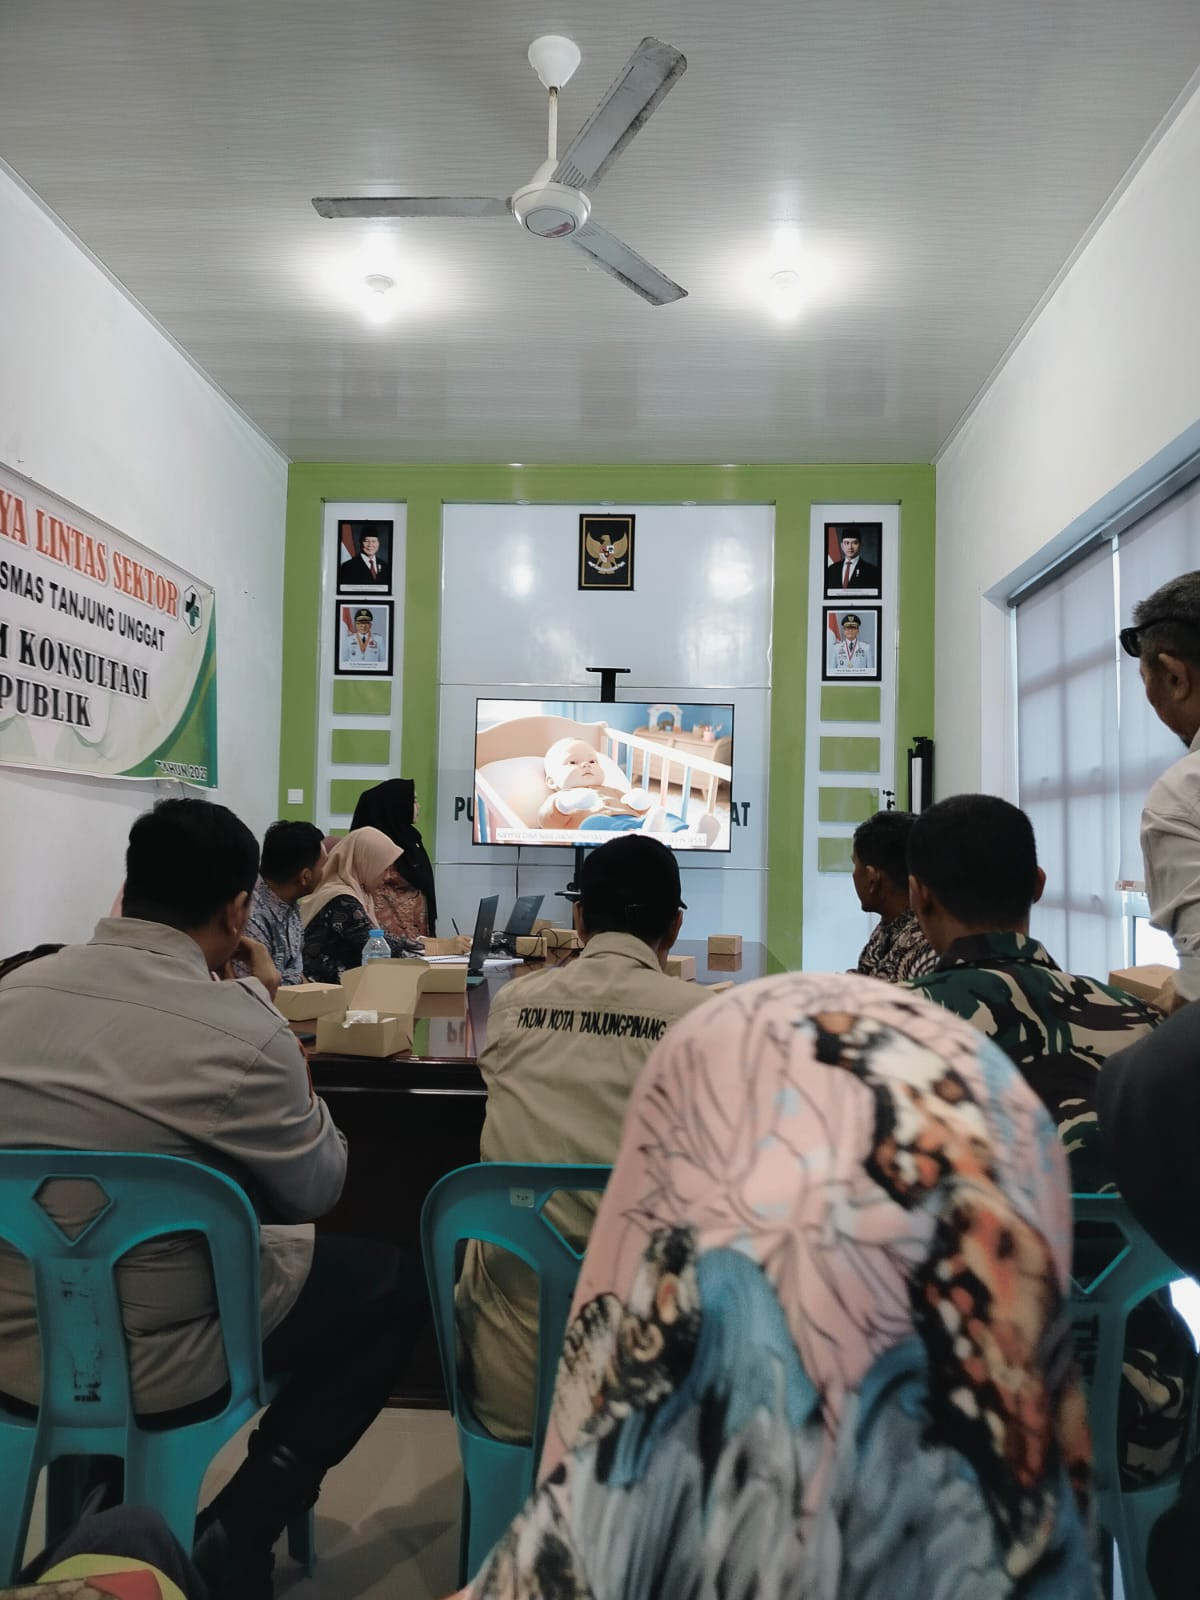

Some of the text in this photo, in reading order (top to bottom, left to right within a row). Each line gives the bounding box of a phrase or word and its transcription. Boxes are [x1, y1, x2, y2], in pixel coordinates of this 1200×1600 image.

[36, 508, 107, 583] LINTAS
[113, 551, 178, 617] SEKTOR
[0, 561, 166, 651] SMAS TANJUNG UNGGAT
[19, 629, 149, 700] KONSULTASI
[0, 673, 91, 727] PUBLIK
[155, 760, 188, 778] TAHUN
[517, 1007, 667, 1041] FKDM KOTA TANJUNGPINANG
